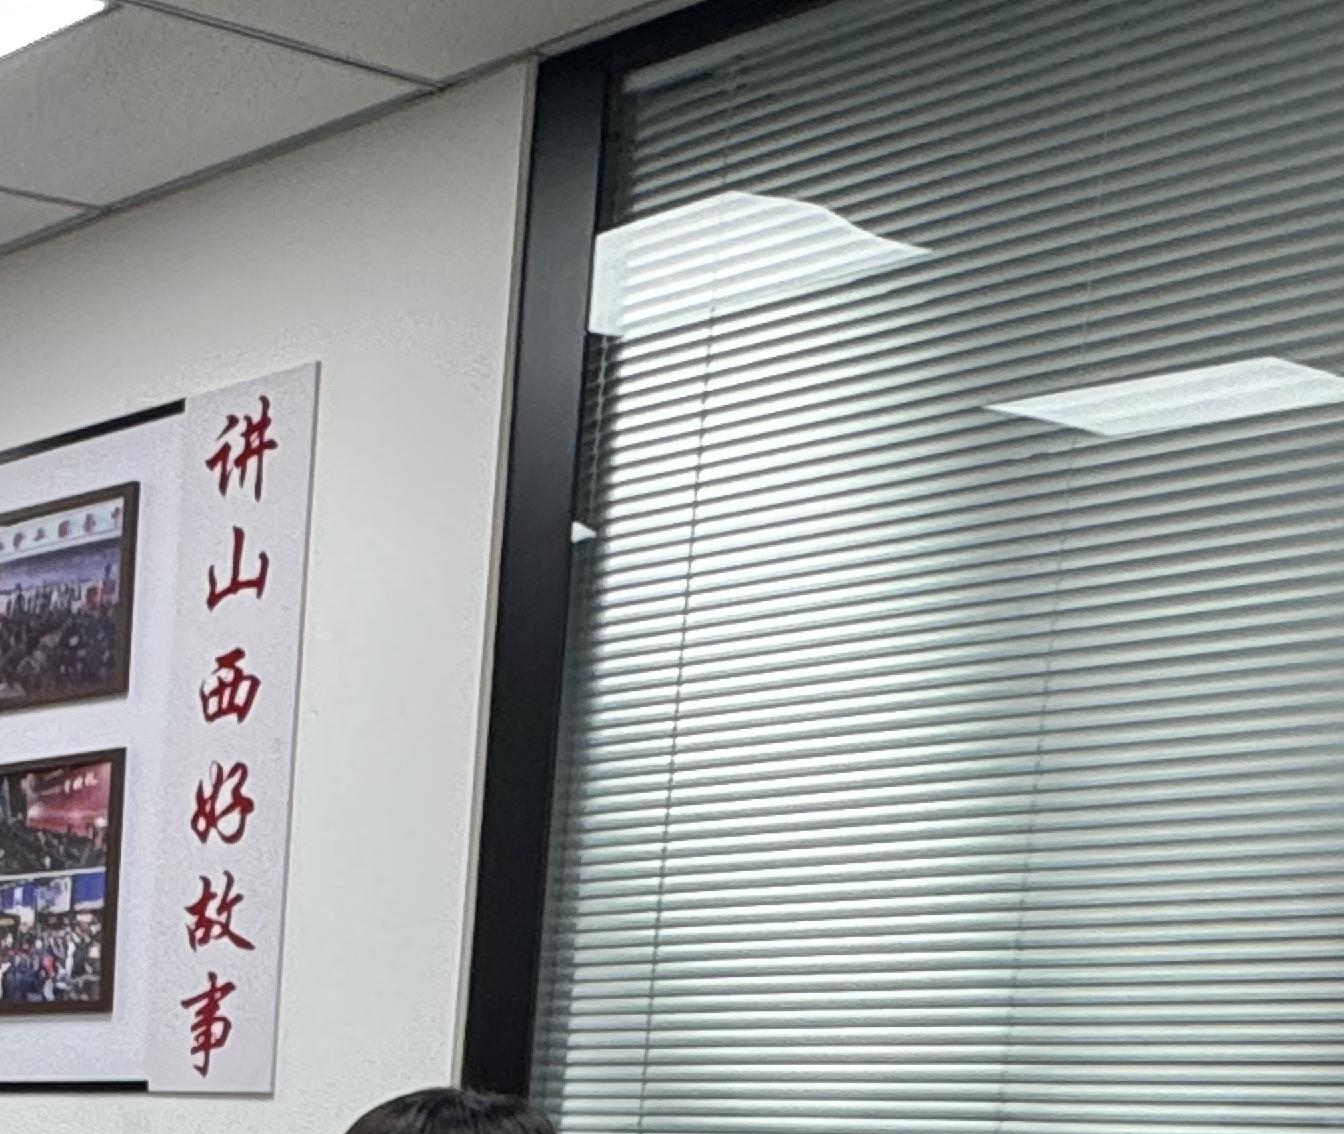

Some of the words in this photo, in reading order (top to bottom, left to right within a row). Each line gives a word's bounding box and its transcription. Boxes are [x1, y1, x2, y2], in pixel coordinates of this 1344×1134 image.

[180, 395, 278, 1078] 讲山西好故事
